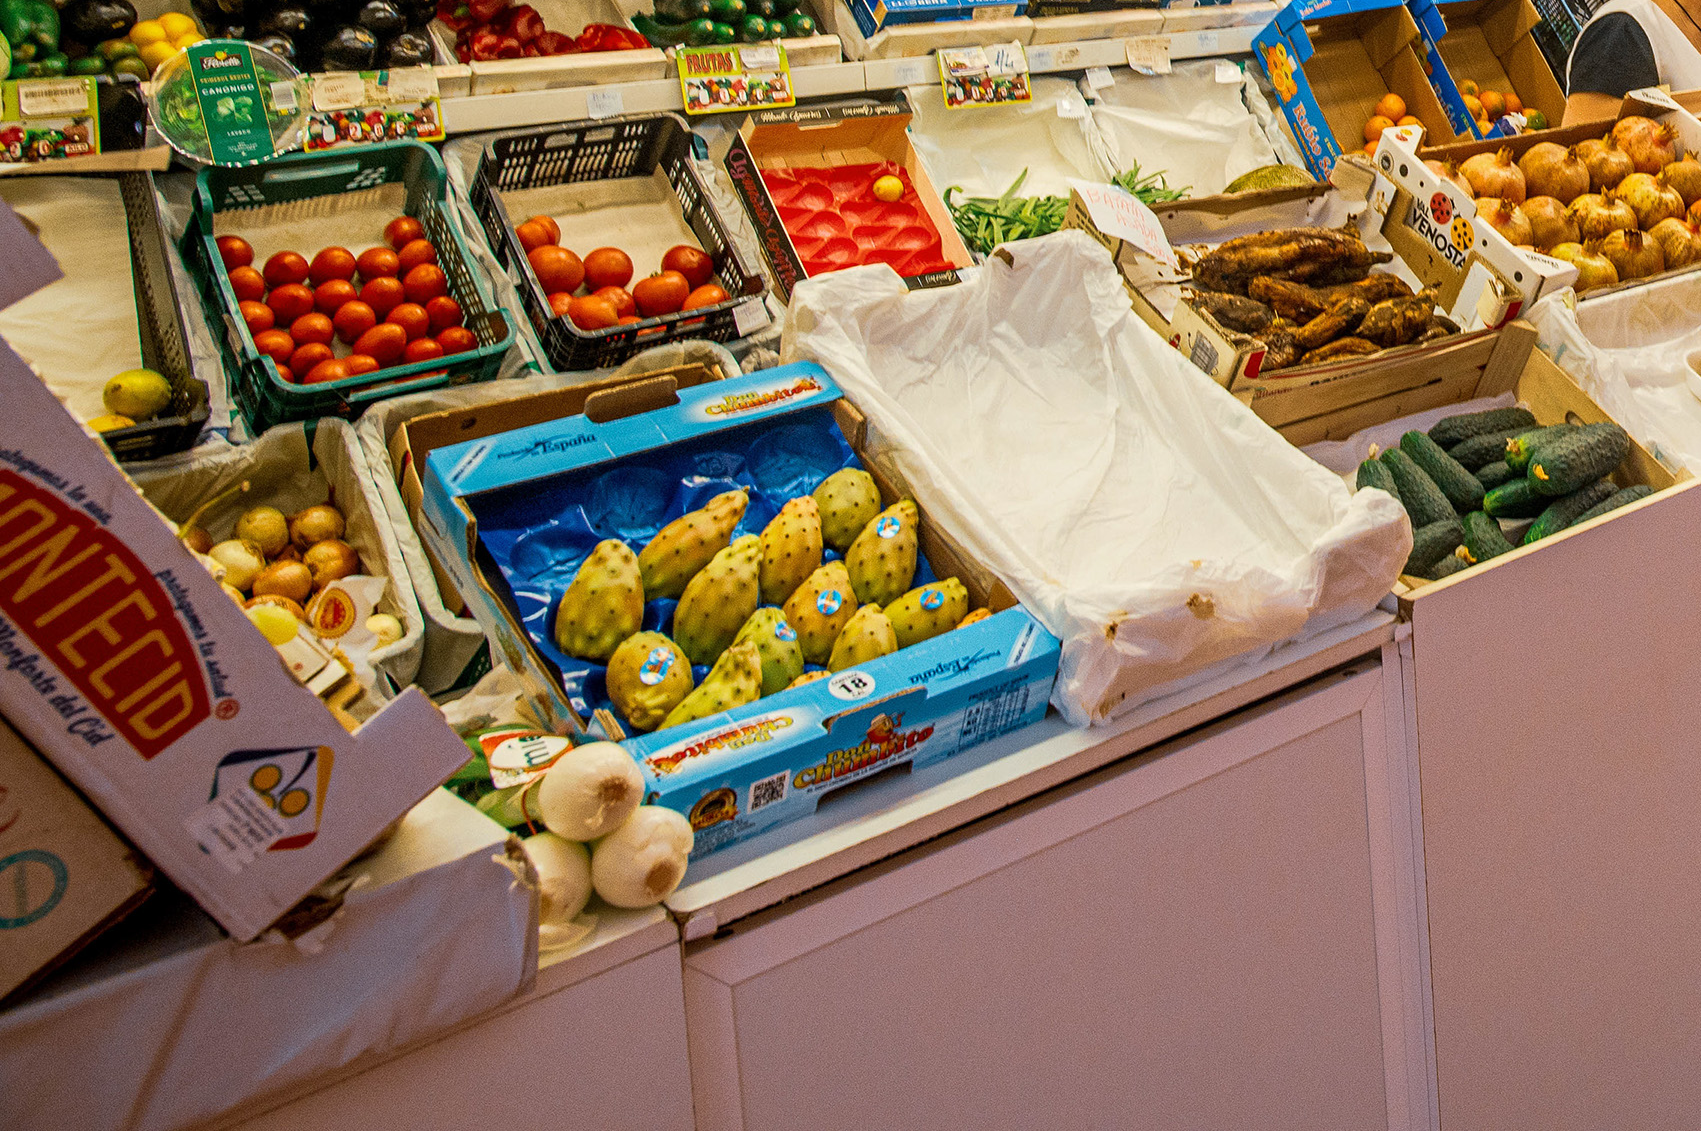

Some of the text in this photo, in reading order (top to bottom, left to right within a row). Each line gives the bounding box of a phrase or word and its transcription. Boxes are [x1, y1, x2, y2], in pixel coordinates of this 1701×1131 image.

[684, 52, 737, 74] FRUTAS
[1292, 100, 1323, 157] Rubio
[1416, 197, 1428, 218] VAL
[1412, 208, 1466, 268] VENOSTA
[538, 432, 597, 457] España
[0, 481, 194, 740] ONTECID
[838, 675, 868, 694] 18
[49, 693, 88, 719] del
[67, 716, 115, 747] Cid
[792, 722, 936, 771] Chumbito
